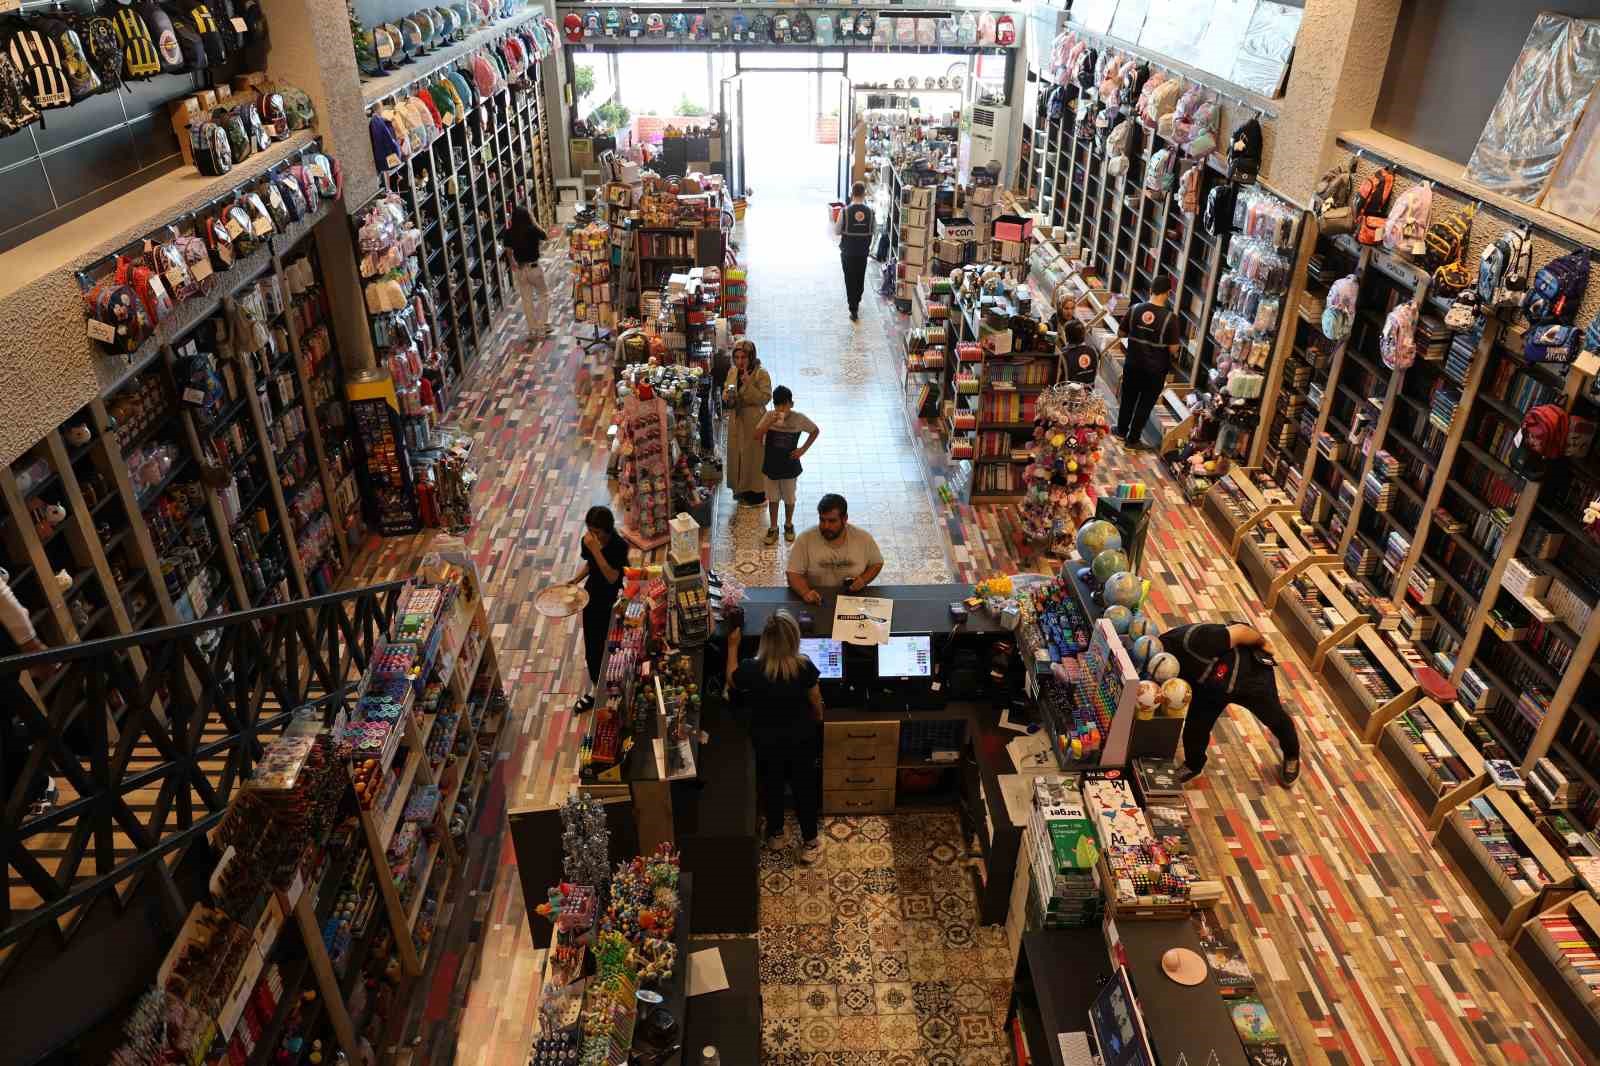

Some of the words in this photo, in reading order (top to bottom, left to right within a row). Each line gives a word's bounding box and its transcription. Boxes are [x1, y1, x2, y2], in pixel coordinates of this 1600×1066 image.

[955, 228, 974, 236] can
[1050, 808, 1082, 816] target
[1111, 833, 1127, 845] A4
